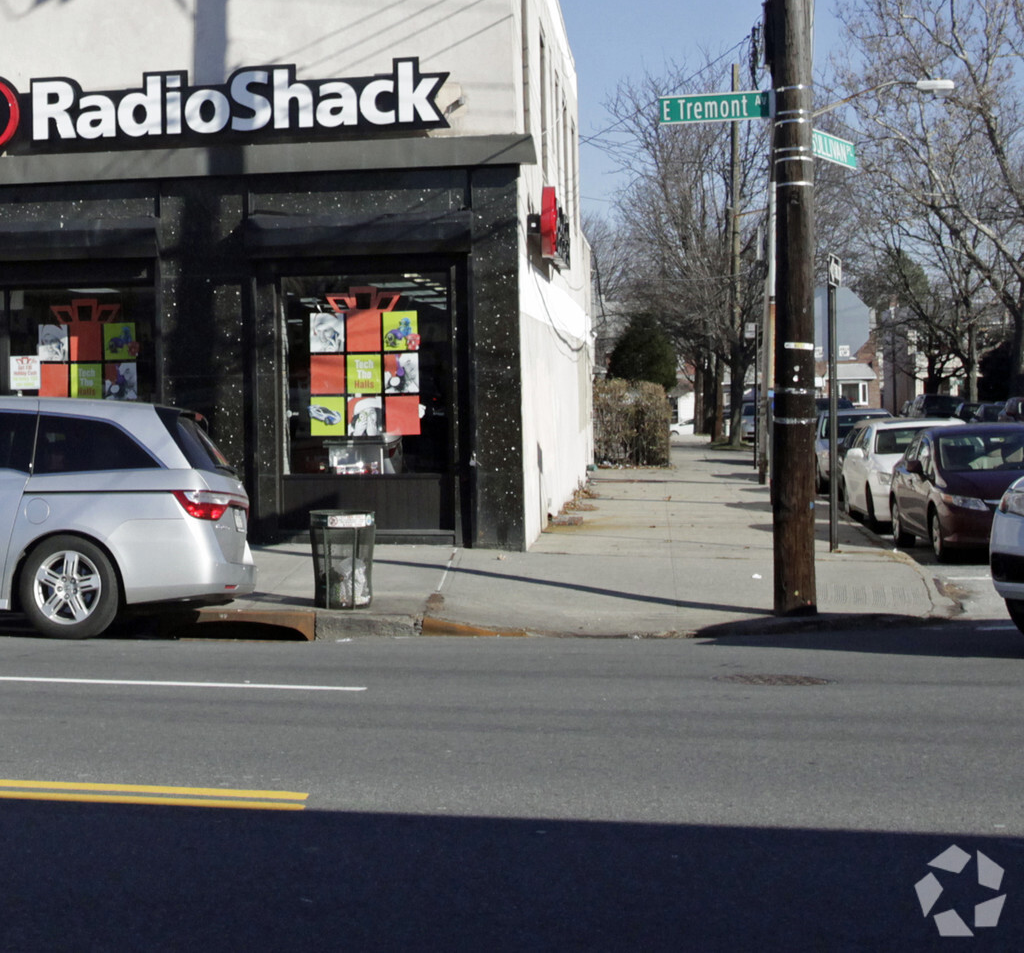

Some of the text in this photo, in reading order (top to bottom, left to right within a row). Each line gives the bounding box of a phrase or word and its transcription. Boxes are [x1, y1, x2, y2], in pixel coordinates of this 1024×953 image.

[31, 60, 444, 141] RadioShack
[662, 100, 671, 121] E
[678, 95, 748, 119] Tremont
[354, 359, 374, 369] Tech
[78, 368, 96, 377] Tech
[357, 370, 372, 379] The
[354, 380, 374, 389] Halls
